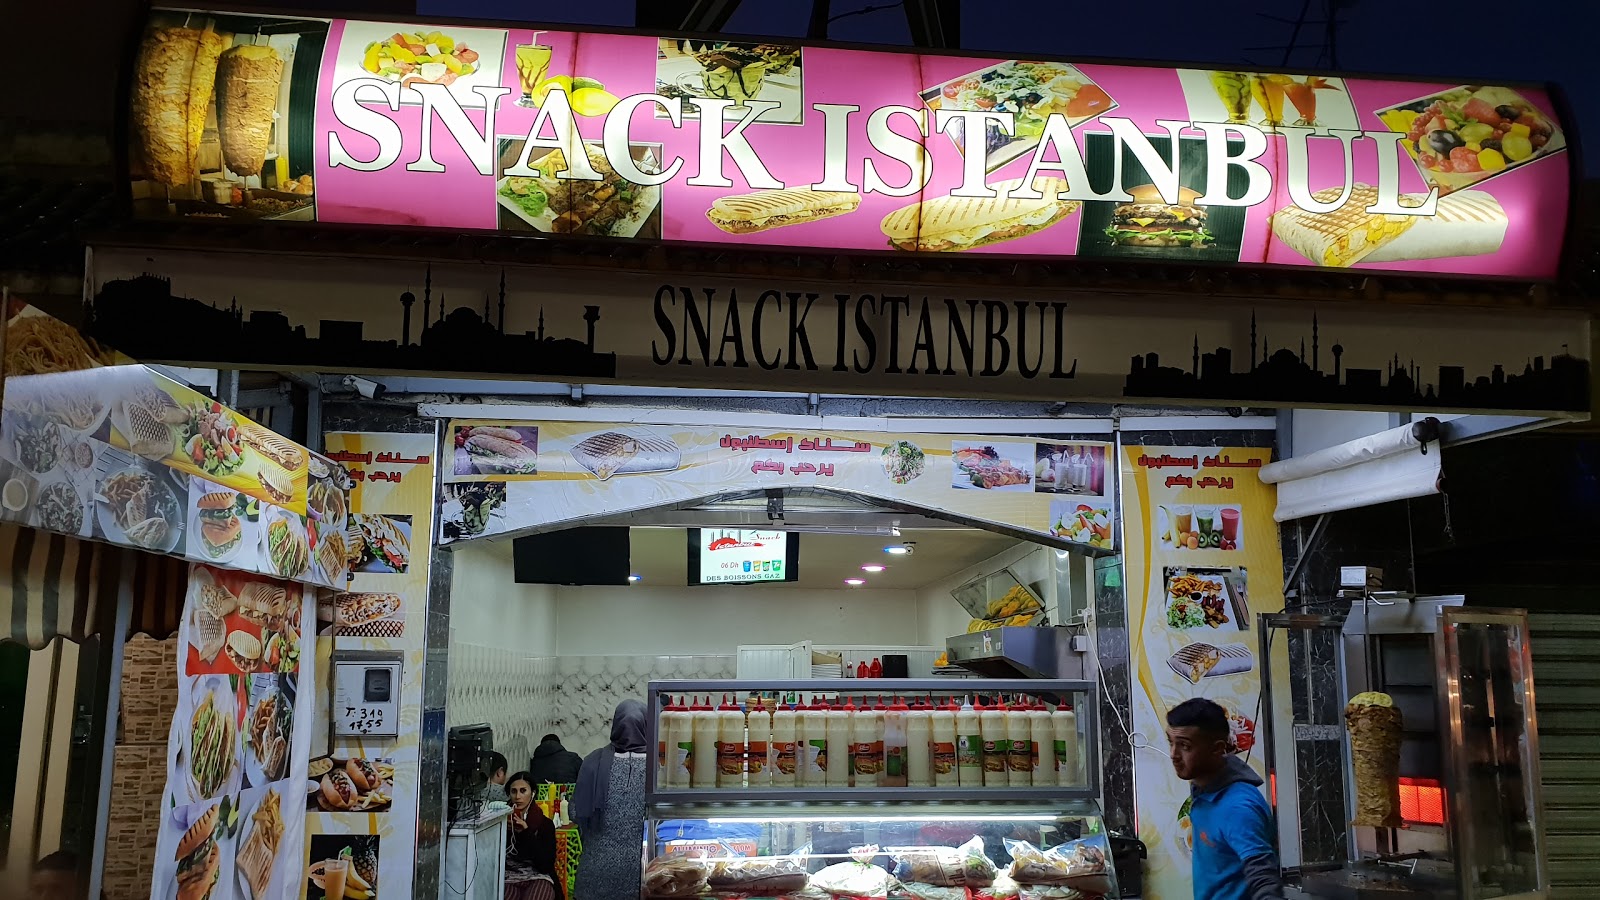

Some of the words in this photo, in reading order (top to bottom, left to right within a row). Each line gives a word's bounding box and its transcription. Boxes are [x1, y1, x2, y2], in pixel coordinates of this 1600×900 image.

[328, 77, 786, 190] SNACK
[811, 102, 1440, 217] ISTANBUL
[651, 284, 820, 371] SNACK
[832, 293, 1078, 380] ISTANBUL
[751, 458, 785, 475] بكم
[789, 461, 835, 477] يرحب
[1164, 473, 1193, 488] بكم
[1196, 476, 1234, 489] يرحب
[349, 720, 383, 730] 1755
